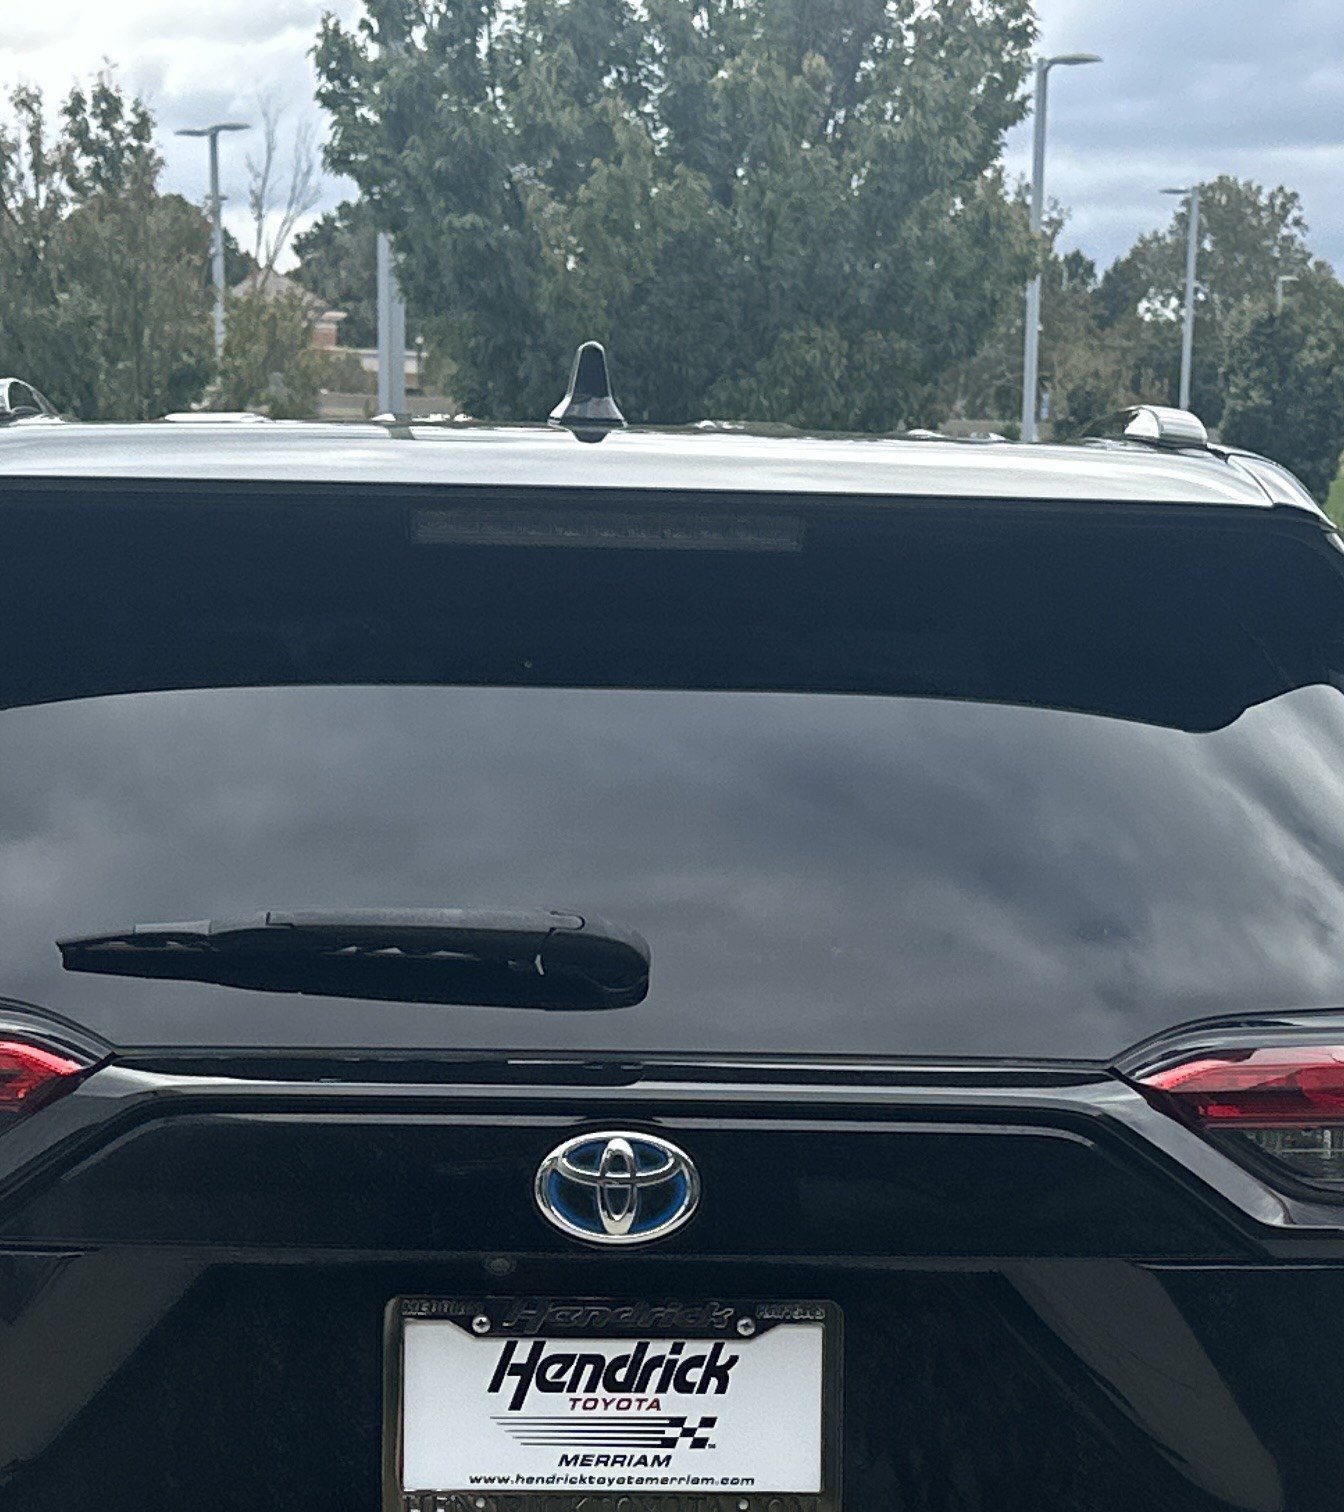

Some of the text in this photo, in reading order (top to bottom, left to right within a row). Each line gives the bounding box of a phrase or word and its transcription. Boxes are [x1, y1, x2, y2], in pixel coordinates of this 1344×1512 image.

[501, 1299, 736, 1335] Hendrick
[487, 1340, 739, 1411] Hendrick
[568, 1398, 662, 1411] TOYOTA
[558, 1454, 672, 1468] MERRIAM
[468, 1473, 756, 1487] www.hendricktoyotamerriam.com
